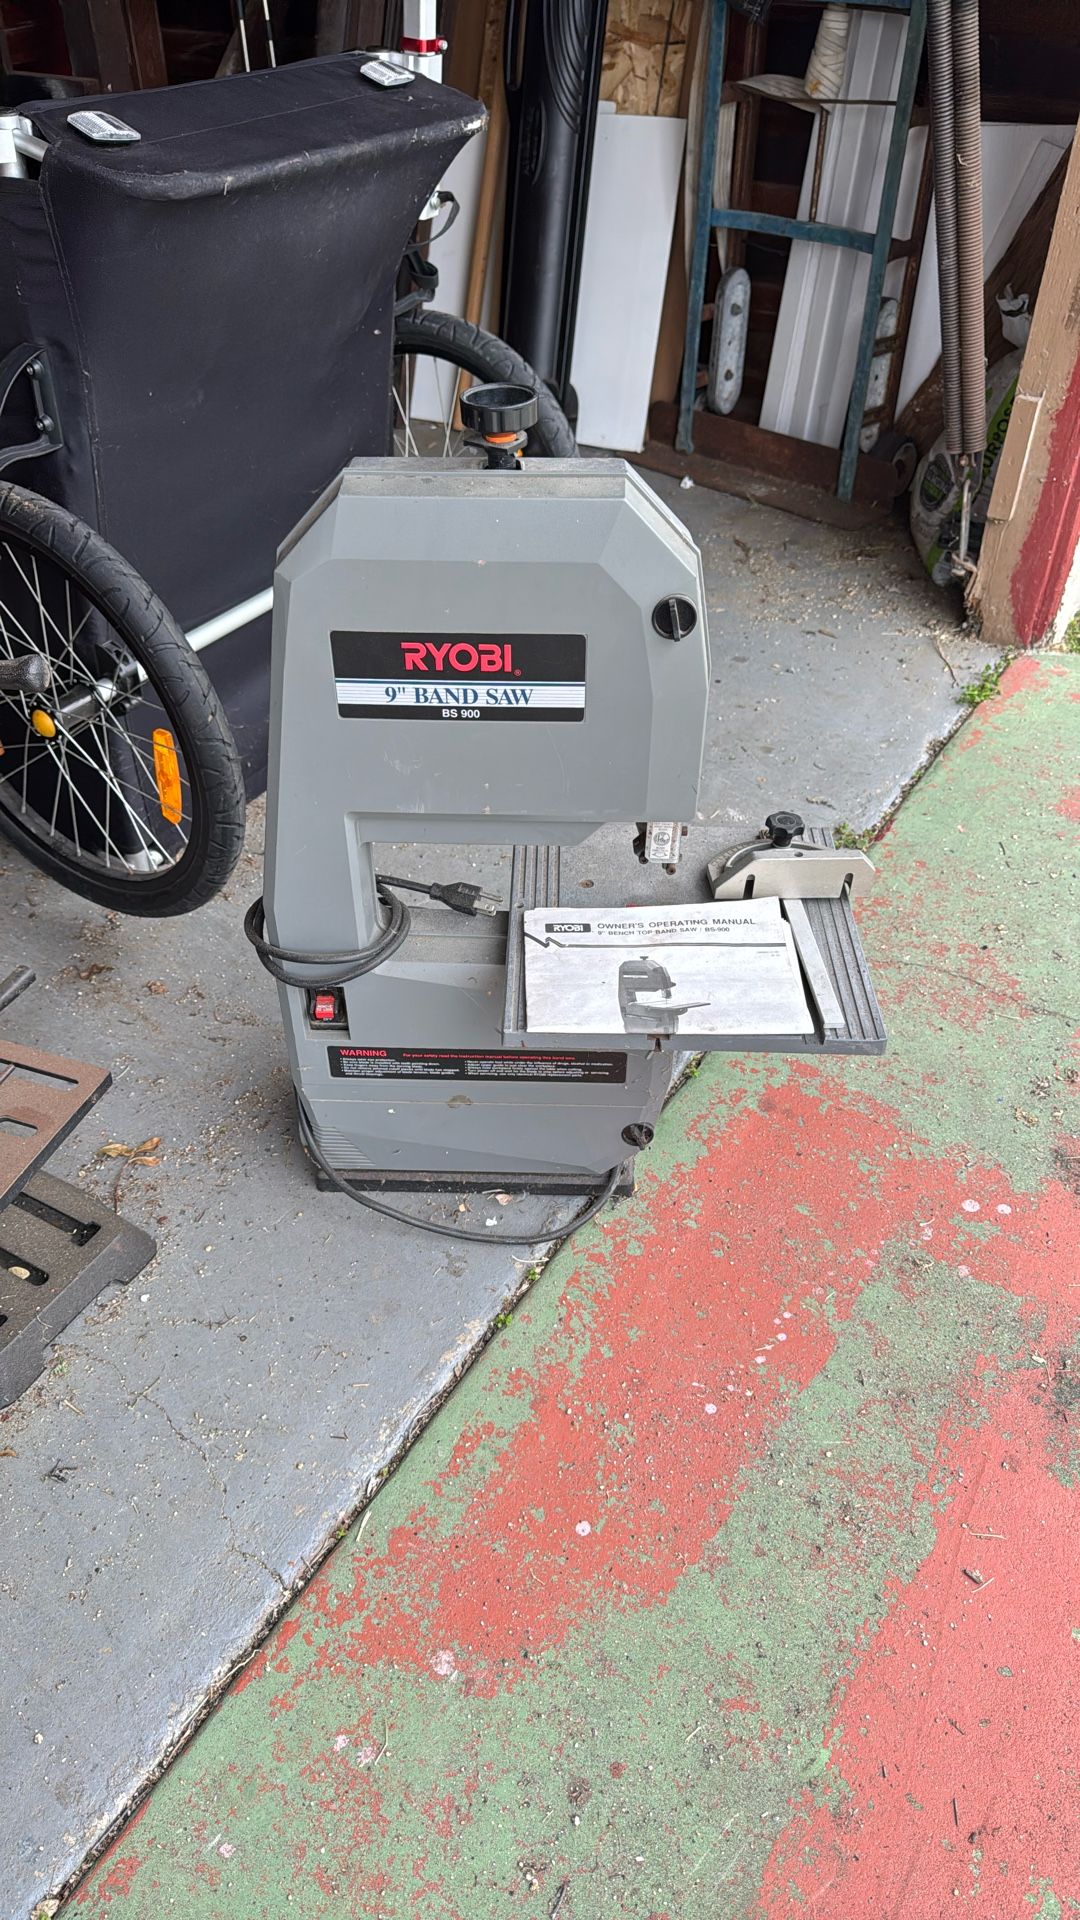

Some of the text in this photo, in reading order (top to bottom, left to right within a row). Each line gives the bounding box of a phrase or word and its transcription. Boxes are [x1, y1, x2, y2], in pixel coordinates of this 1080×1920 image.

[400, 641, 512, 673] RYOBI
[385, 686, 533, 706] 9" BAND SAW
[442, 708, 480, 719] BS 900
[553, 924, 584, 932] RYOBI
[597, 917, 756, 930] OWNER'S OPERATING MANUAL
[340, 1049, 387, 1057] WARNING
